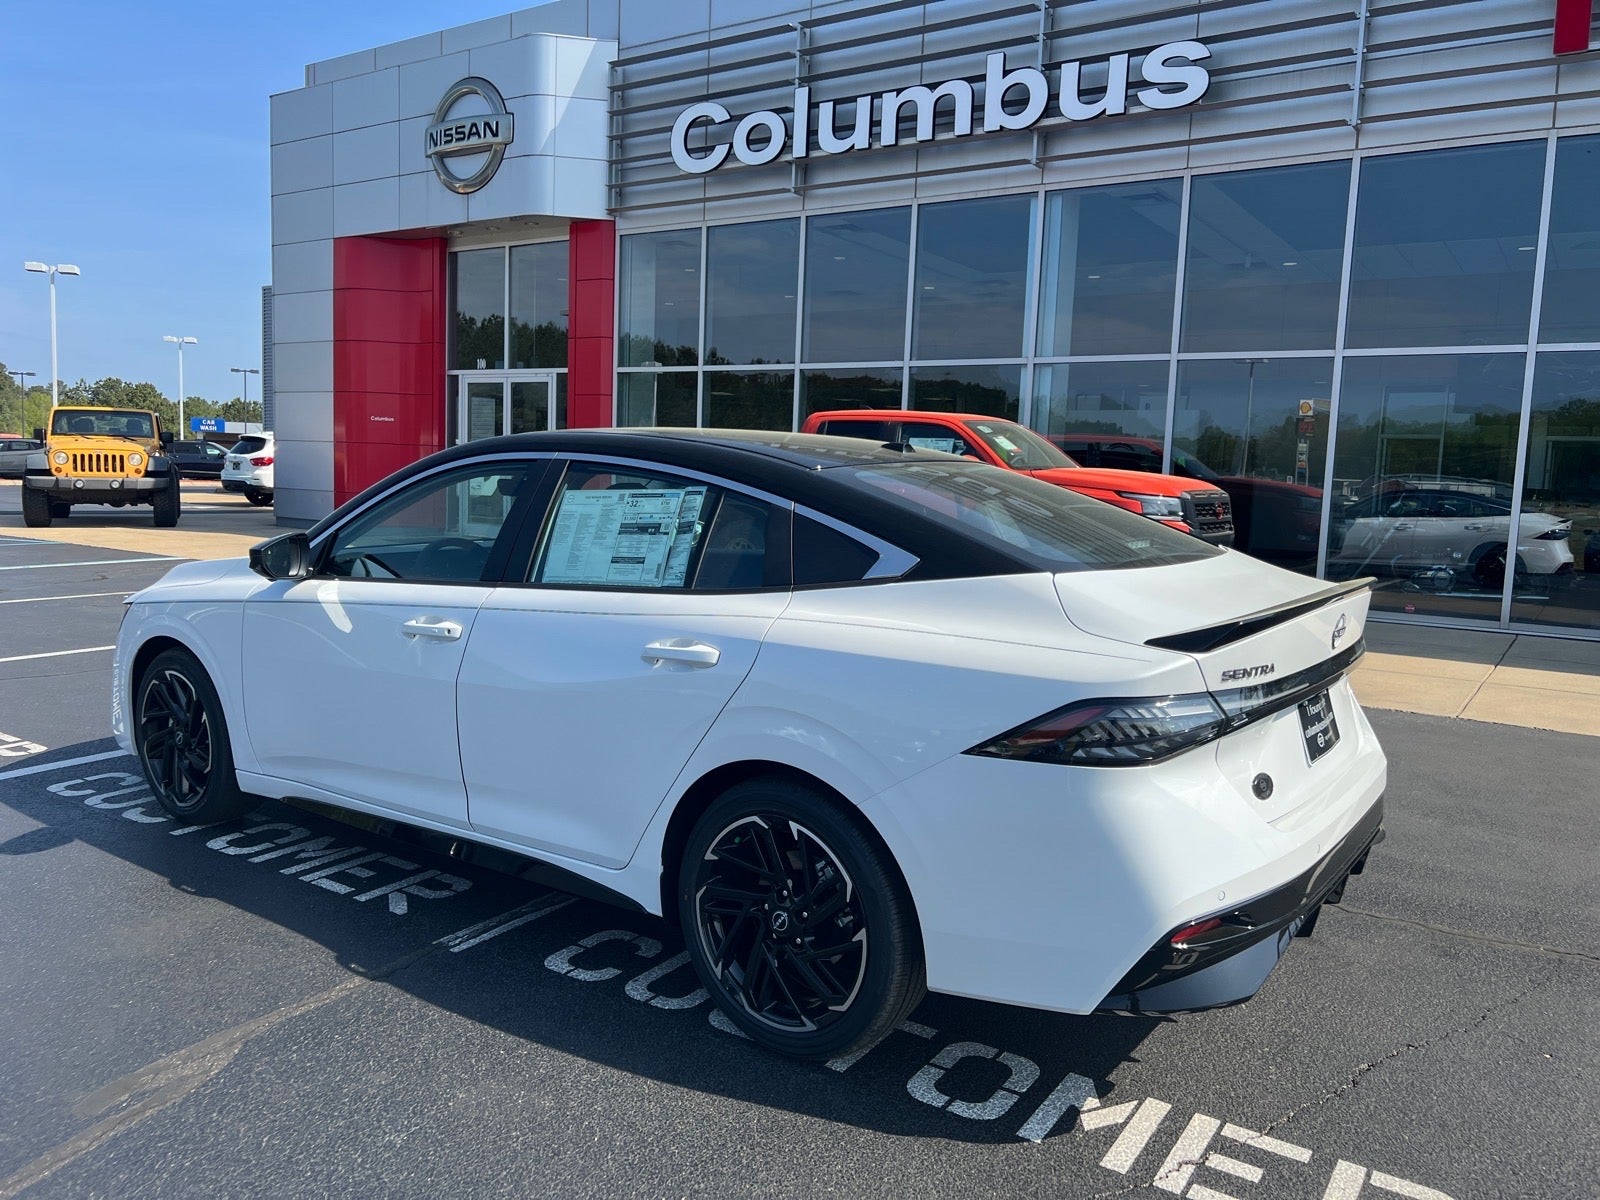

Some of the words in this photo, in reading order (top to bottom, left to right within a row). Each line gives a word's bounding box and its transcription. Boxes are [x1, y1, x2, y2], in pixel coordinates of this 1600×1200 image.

[670, 40, 1212, 174] Columbus
[428, 120, 500, 149] NISSAN
[1221, 663, 1275, 681] SENTRA
